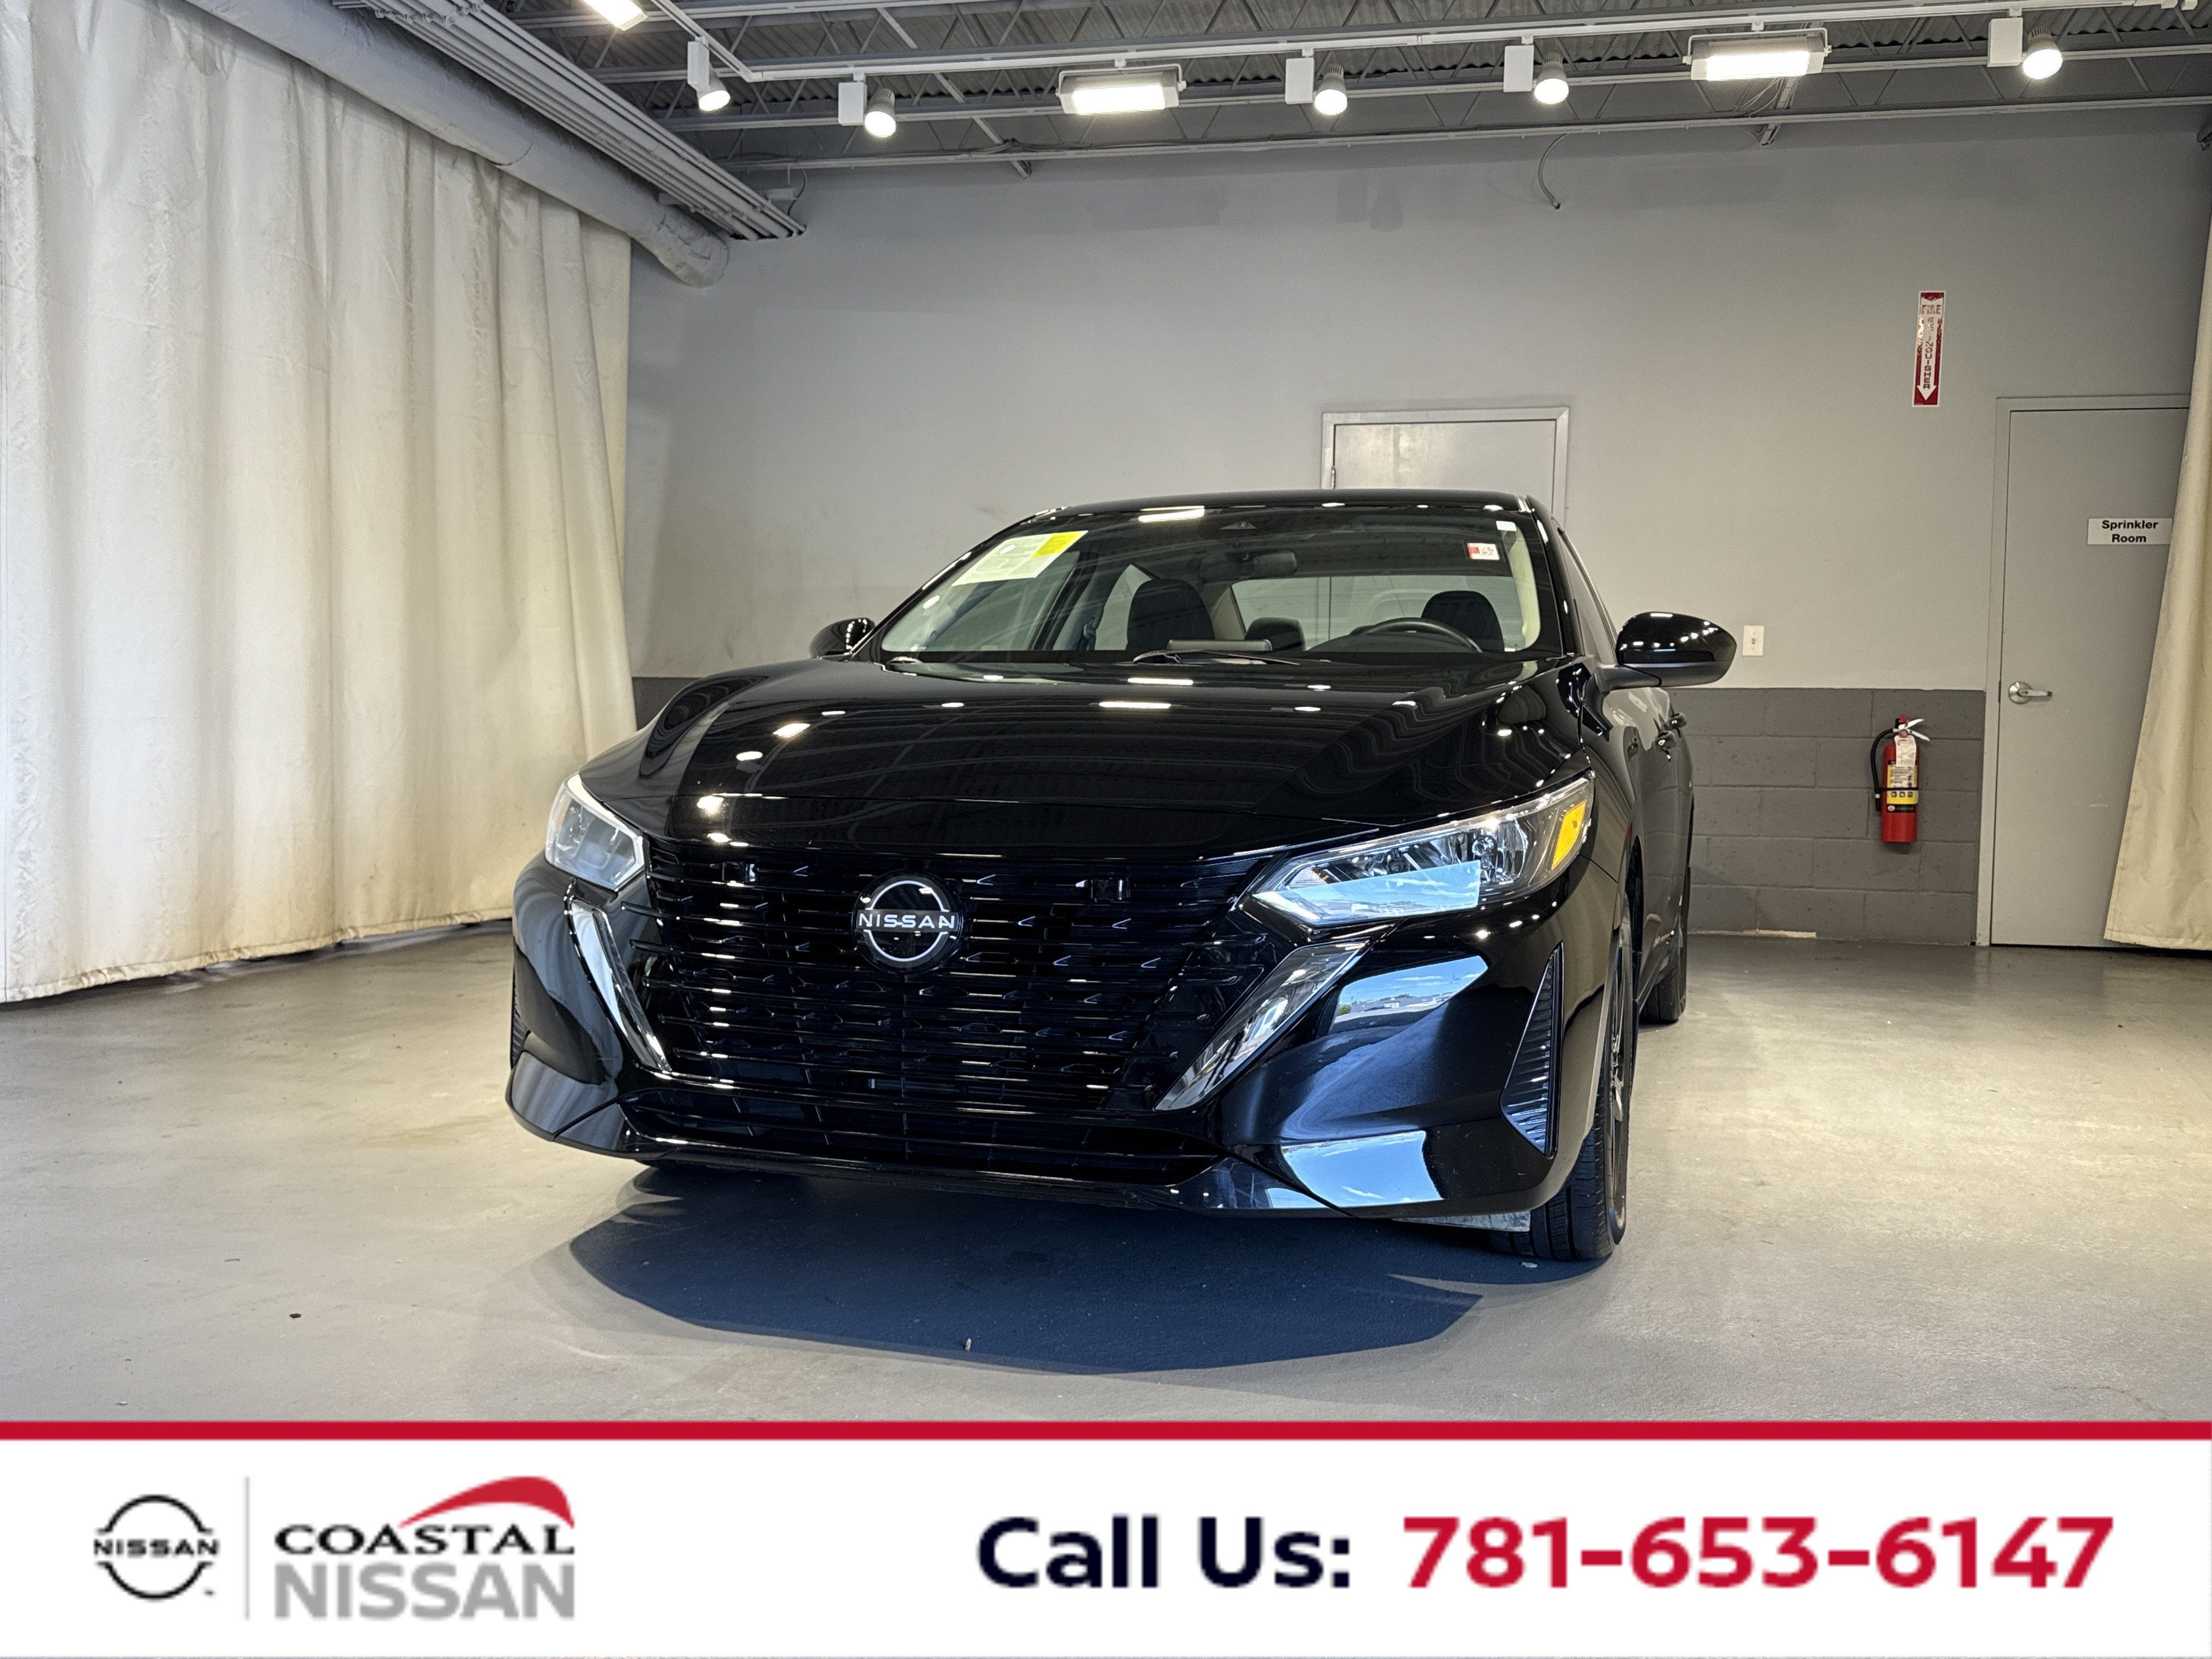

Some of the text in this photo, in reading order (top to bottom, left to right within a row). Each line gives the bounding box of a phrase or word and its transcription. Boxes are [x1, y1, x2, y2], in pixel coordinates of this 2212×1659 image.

[1921, 304, 1942, 314] FIRE
[1923, 317, 1934, 389] INGUISHER
[2101, 520, 2159, 531] Sprinkler
[2112, 534, 2147, 543] Room
[858, 913, 955, 929] NISSAN
